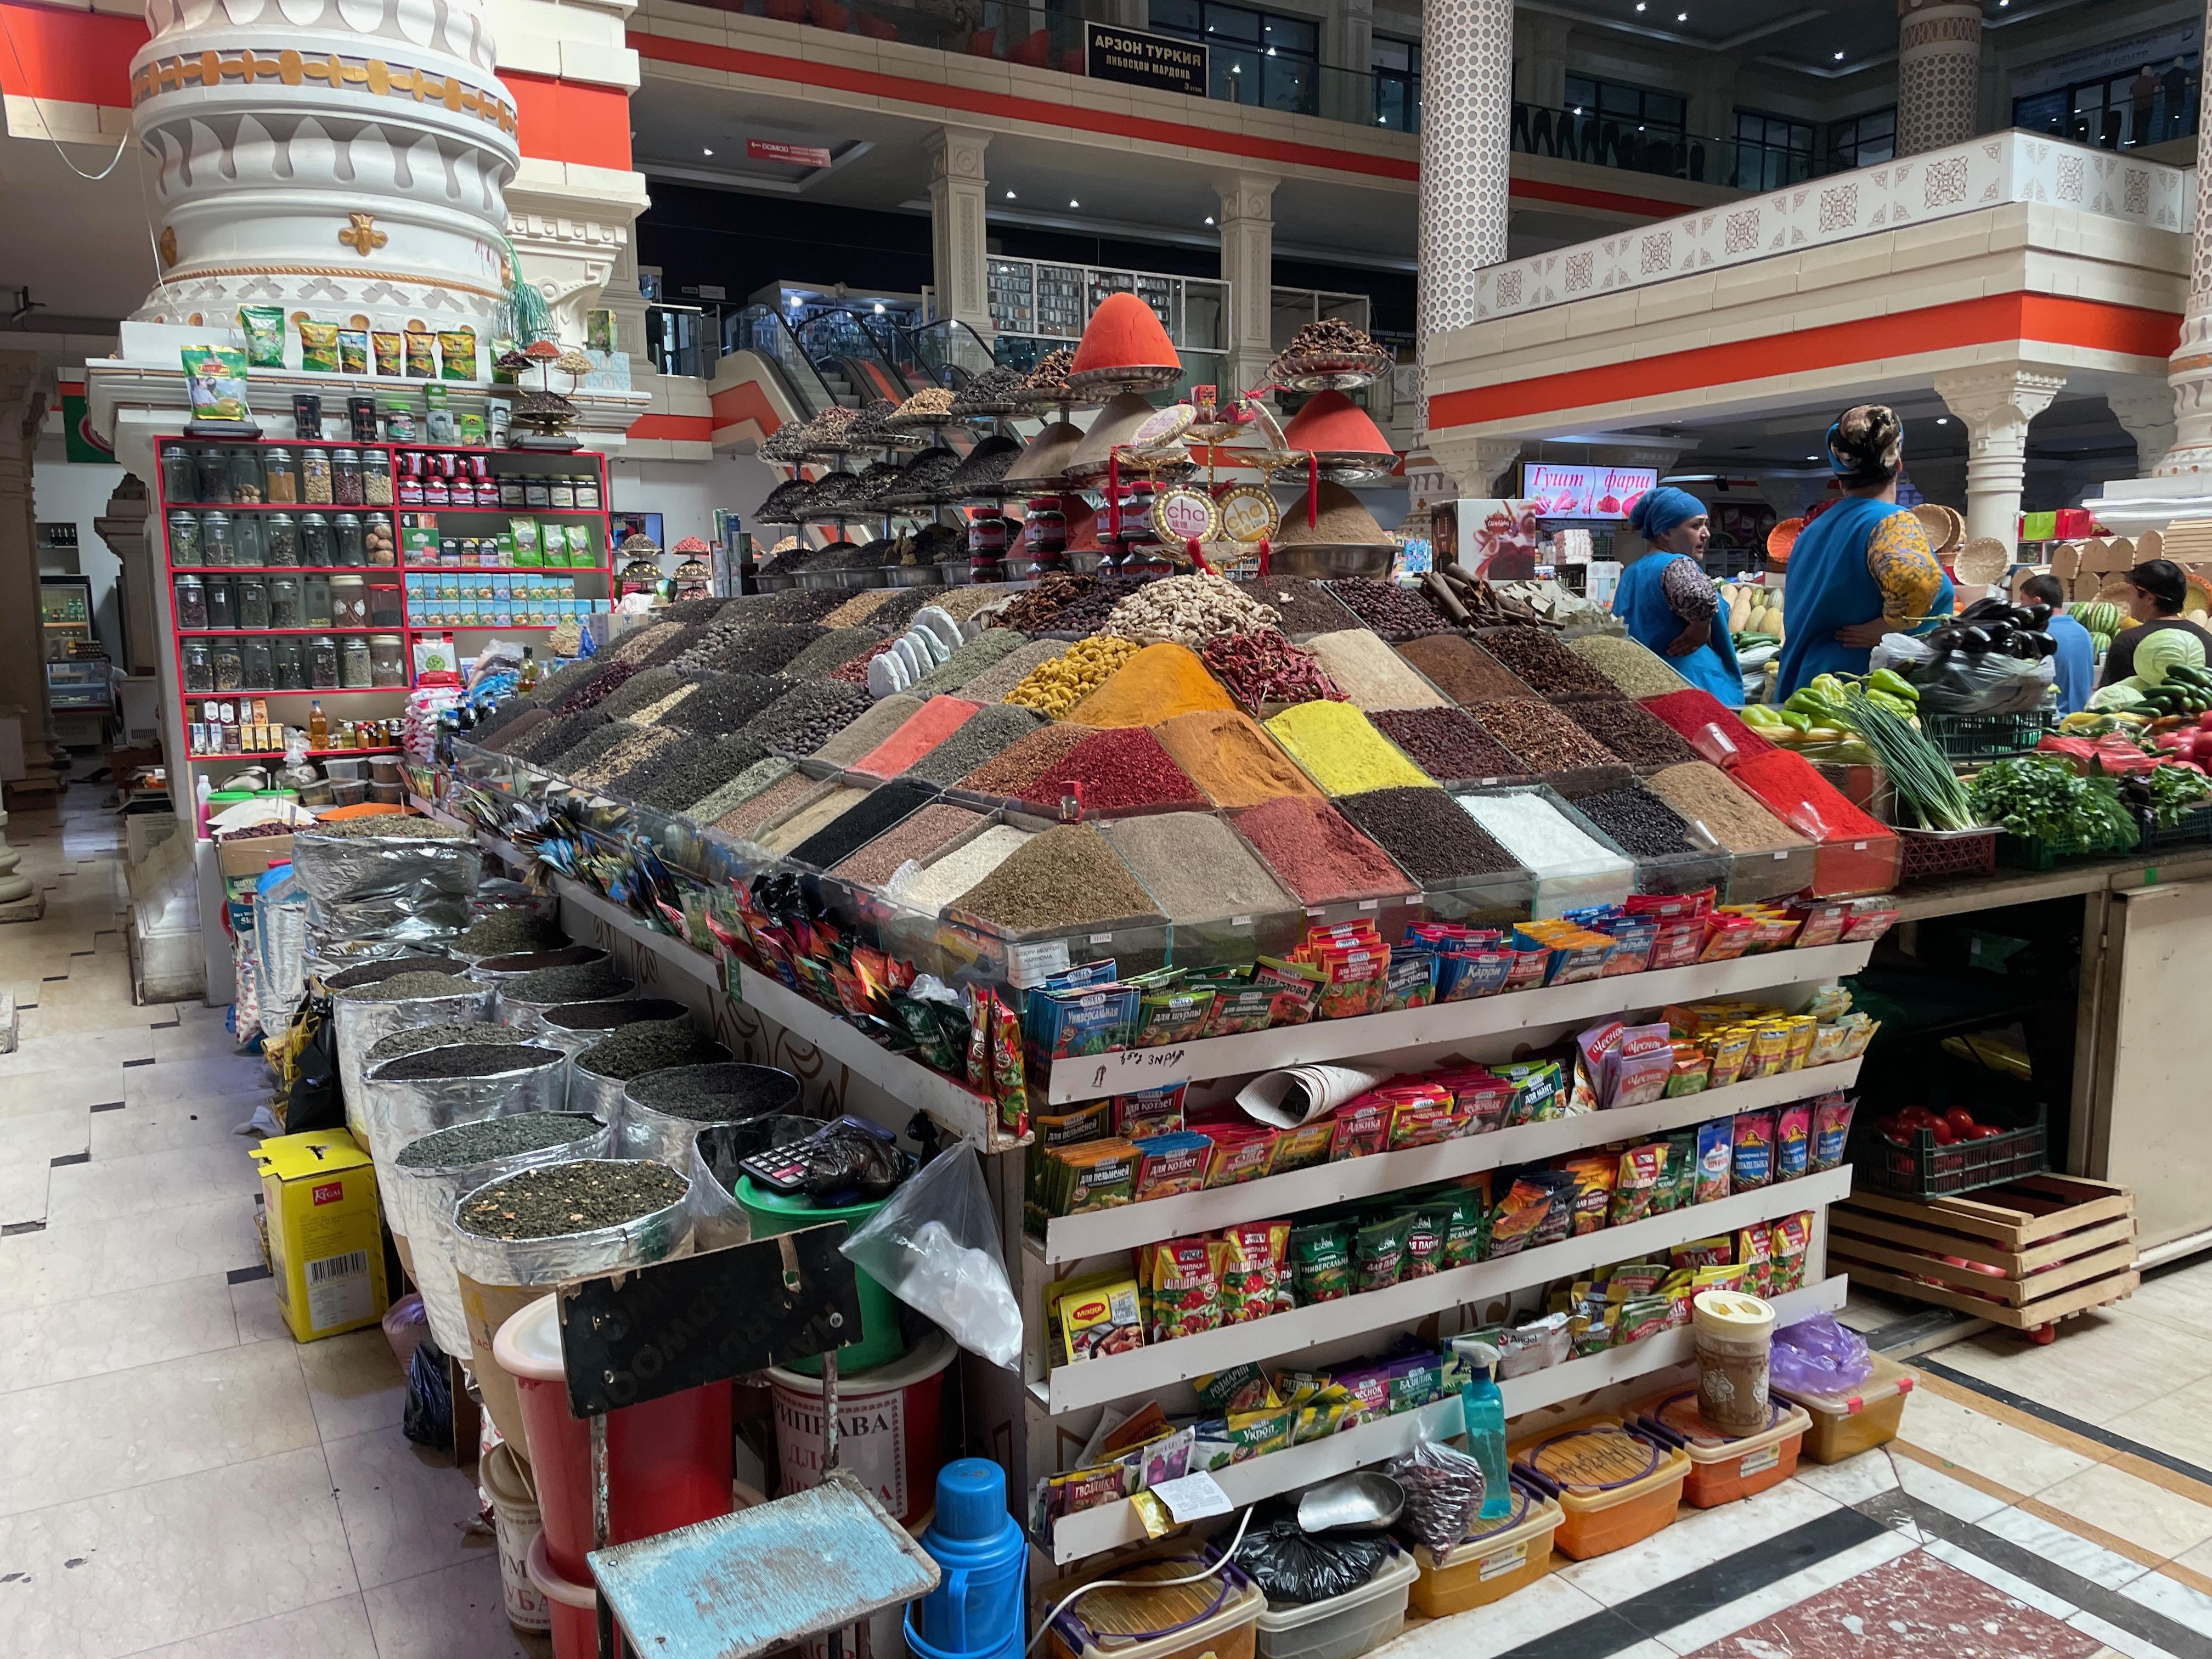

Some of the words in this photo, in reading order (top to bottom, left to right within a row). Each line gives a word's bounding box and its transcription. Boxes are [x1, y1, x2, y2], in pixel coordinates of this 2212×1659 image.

[1095, 35, 1142, 55] АРЗОН
[1146, 44, 1201, 66] ТУРКИЯ
[1152, 64, 1190, 80] МАРДОНА
[1533, 467, 1584, 490] Гушт
[1605, 469, 1651, 493] фарш
[1167, 499, 1205, 522] cha
[1226, 503, 1263, 529] cha
[1468, 965, 1502, 979] Карри
[1082, 994, 1105, 1005] ОМЕГА
[1067, 1007, 1119, 1024] Универсальная
[1153, 1012, 1171, 1023] для
[1628, 1073, 1662, 1085] Чеснок
[1141, 1098, 1173, 1110] котлет
[1347, 1119, 1381, 1134] Аджика
[1079, 1175, 1092, 1184] для
[1093, 1164, 1130, 1183] пельменей
[1150, 1165, 1166, 1176] для
[1167, 1158, 1198, 1171] котлет
[315, 1187, 341, 1204] REGAL
[1242, 1246, 1268, 1255] ПРИПРАВА
[1229, 1257, 1274, 1273] ШАШЛЫКА
[1683, 1251, 1719, 1269] МАК
[1164, 1272, 1215, 1290] ШАШЛЫКА
[1510, 1334, 1537, 1346] Angel
[1210, 1364, 1250, 1398] РОЗМАРИН
[1400, 1373, 1433, 1390] БАЗИЛИК
[1355, 1385, 1383, 1400] ЧЕСНОК
[1243, 1425, 1275, 1442] Укроп
